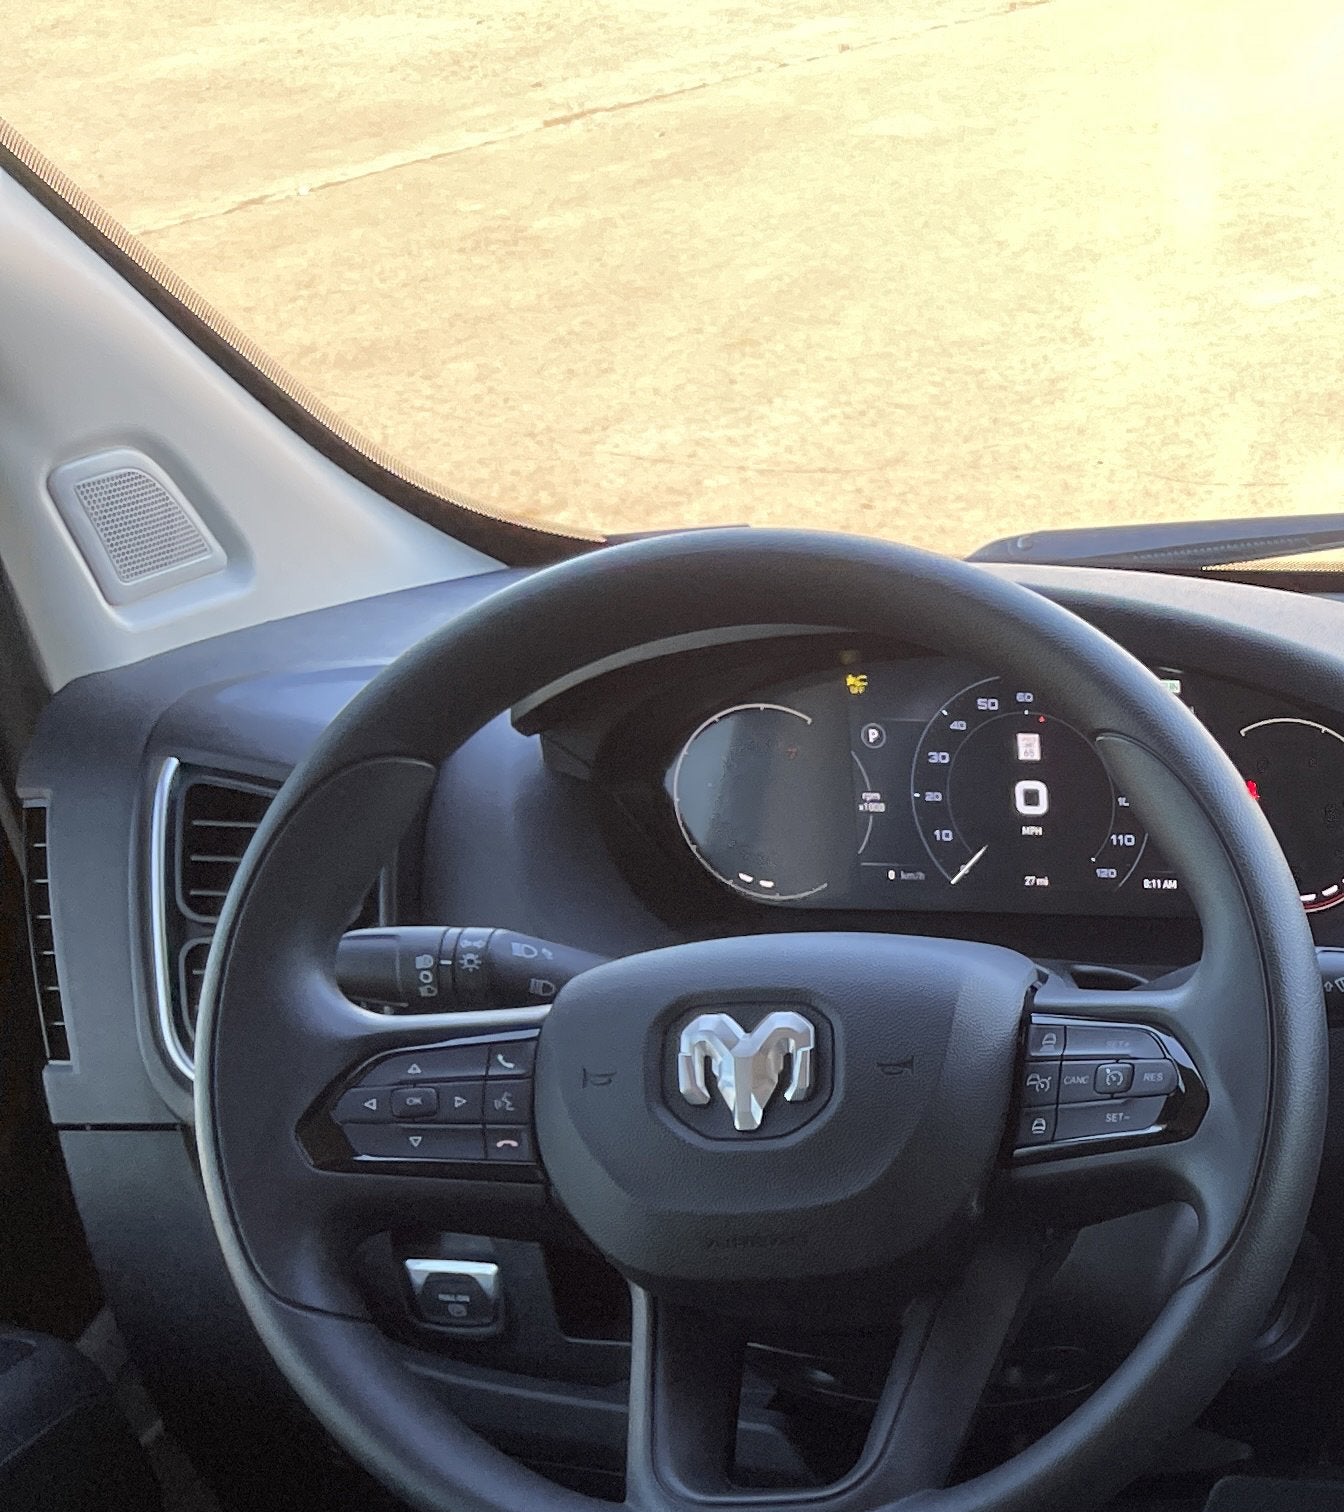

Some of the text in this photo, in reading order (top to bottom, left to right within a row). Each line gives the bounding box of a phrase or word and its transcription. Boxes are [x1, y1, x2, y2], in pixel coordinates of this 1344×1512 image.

[976, 697, 1000, 711] 50
[867, 728, 879, 743] P
[927, 751, 950, 764] 30
[1014, 780, 1049, 816] 0
[933, 829, 953, 842] 10
[1021, 825, 1043, 836] MPH
[1110, 834, 1136, 847] 110
[1162, 879, 1178, 890] AM
[1063, 1075, 1090, 1086] CANC
[1142, 1072, 1164, 1082] RES
[405, 1096, 423, 1106] OK
